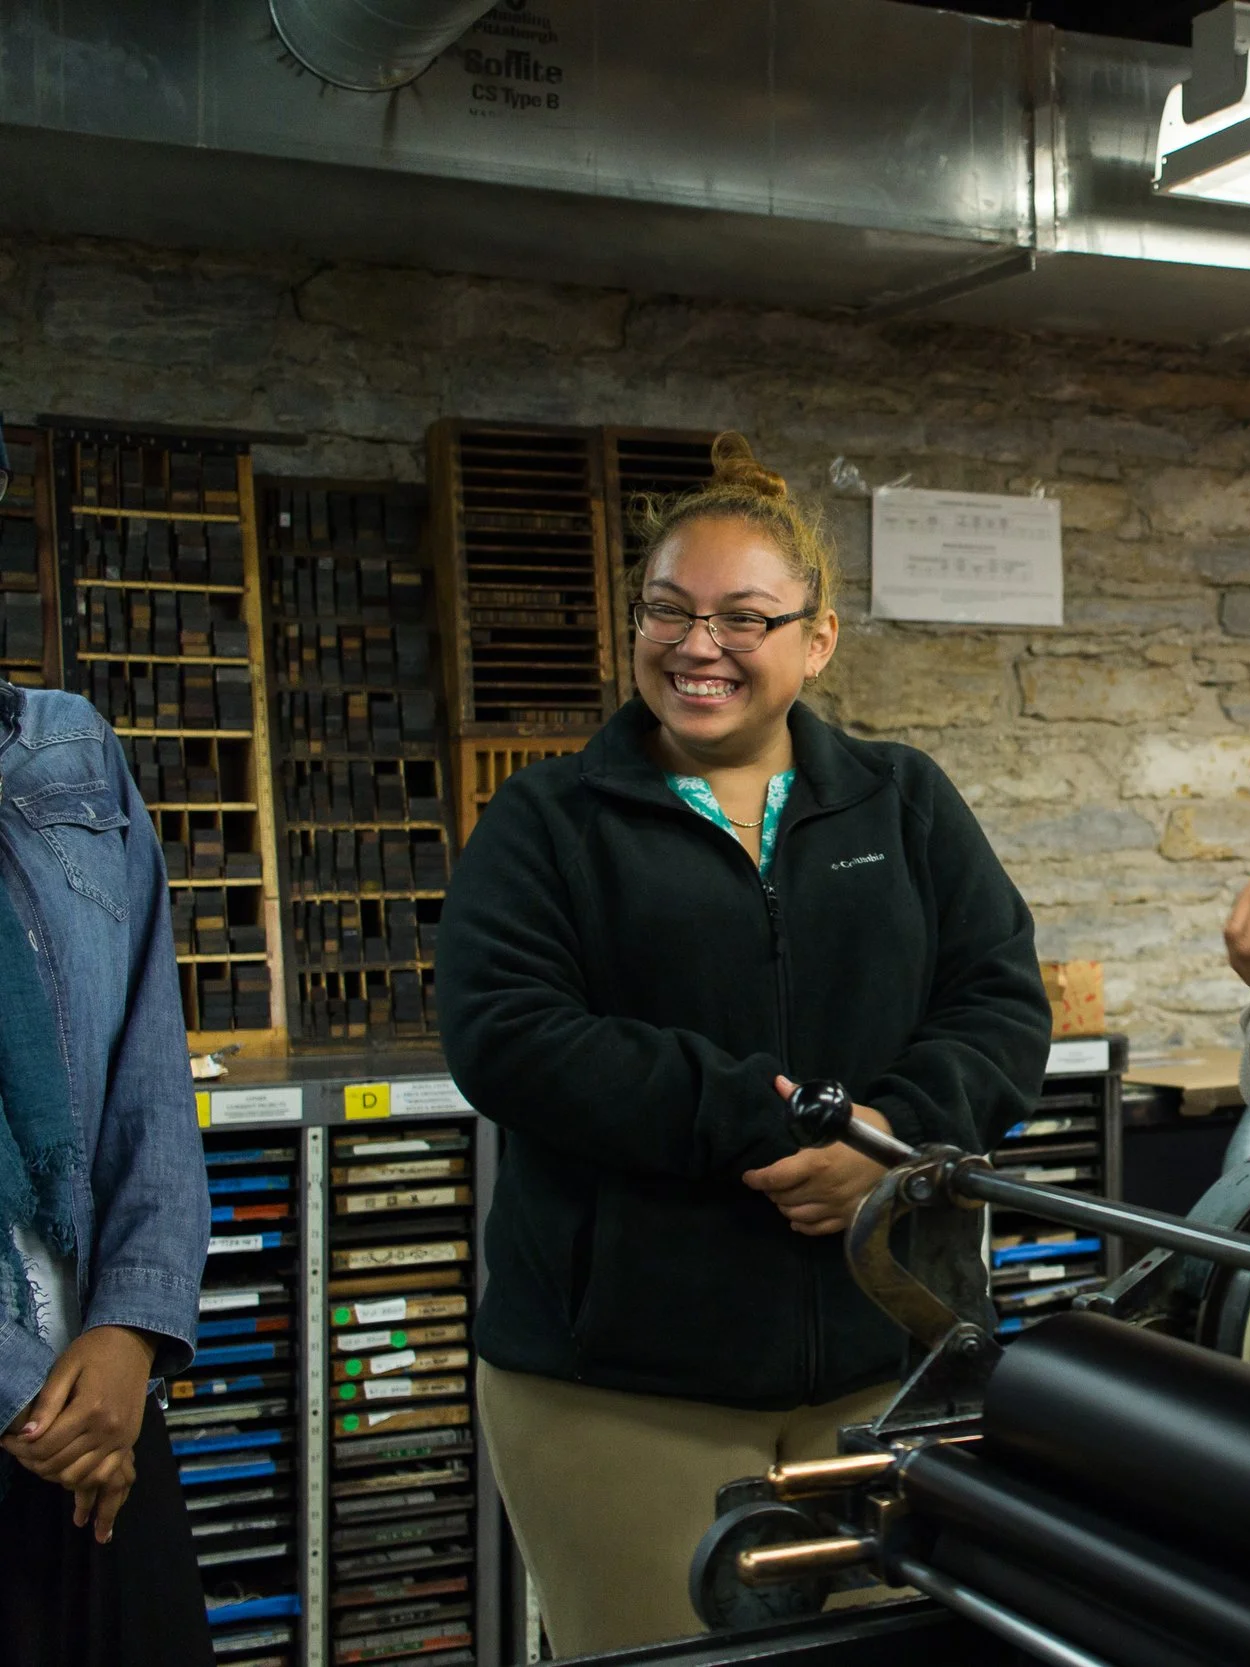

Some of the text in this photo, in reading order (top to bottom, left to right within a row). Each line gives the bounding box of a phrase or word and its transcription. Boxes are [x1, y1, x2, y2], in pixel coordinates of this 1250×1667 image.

[472, 84, 560, 110] CS Type B
[840, 852, 885, 868] Columbia
[362, 1092, 378, 1109] D
